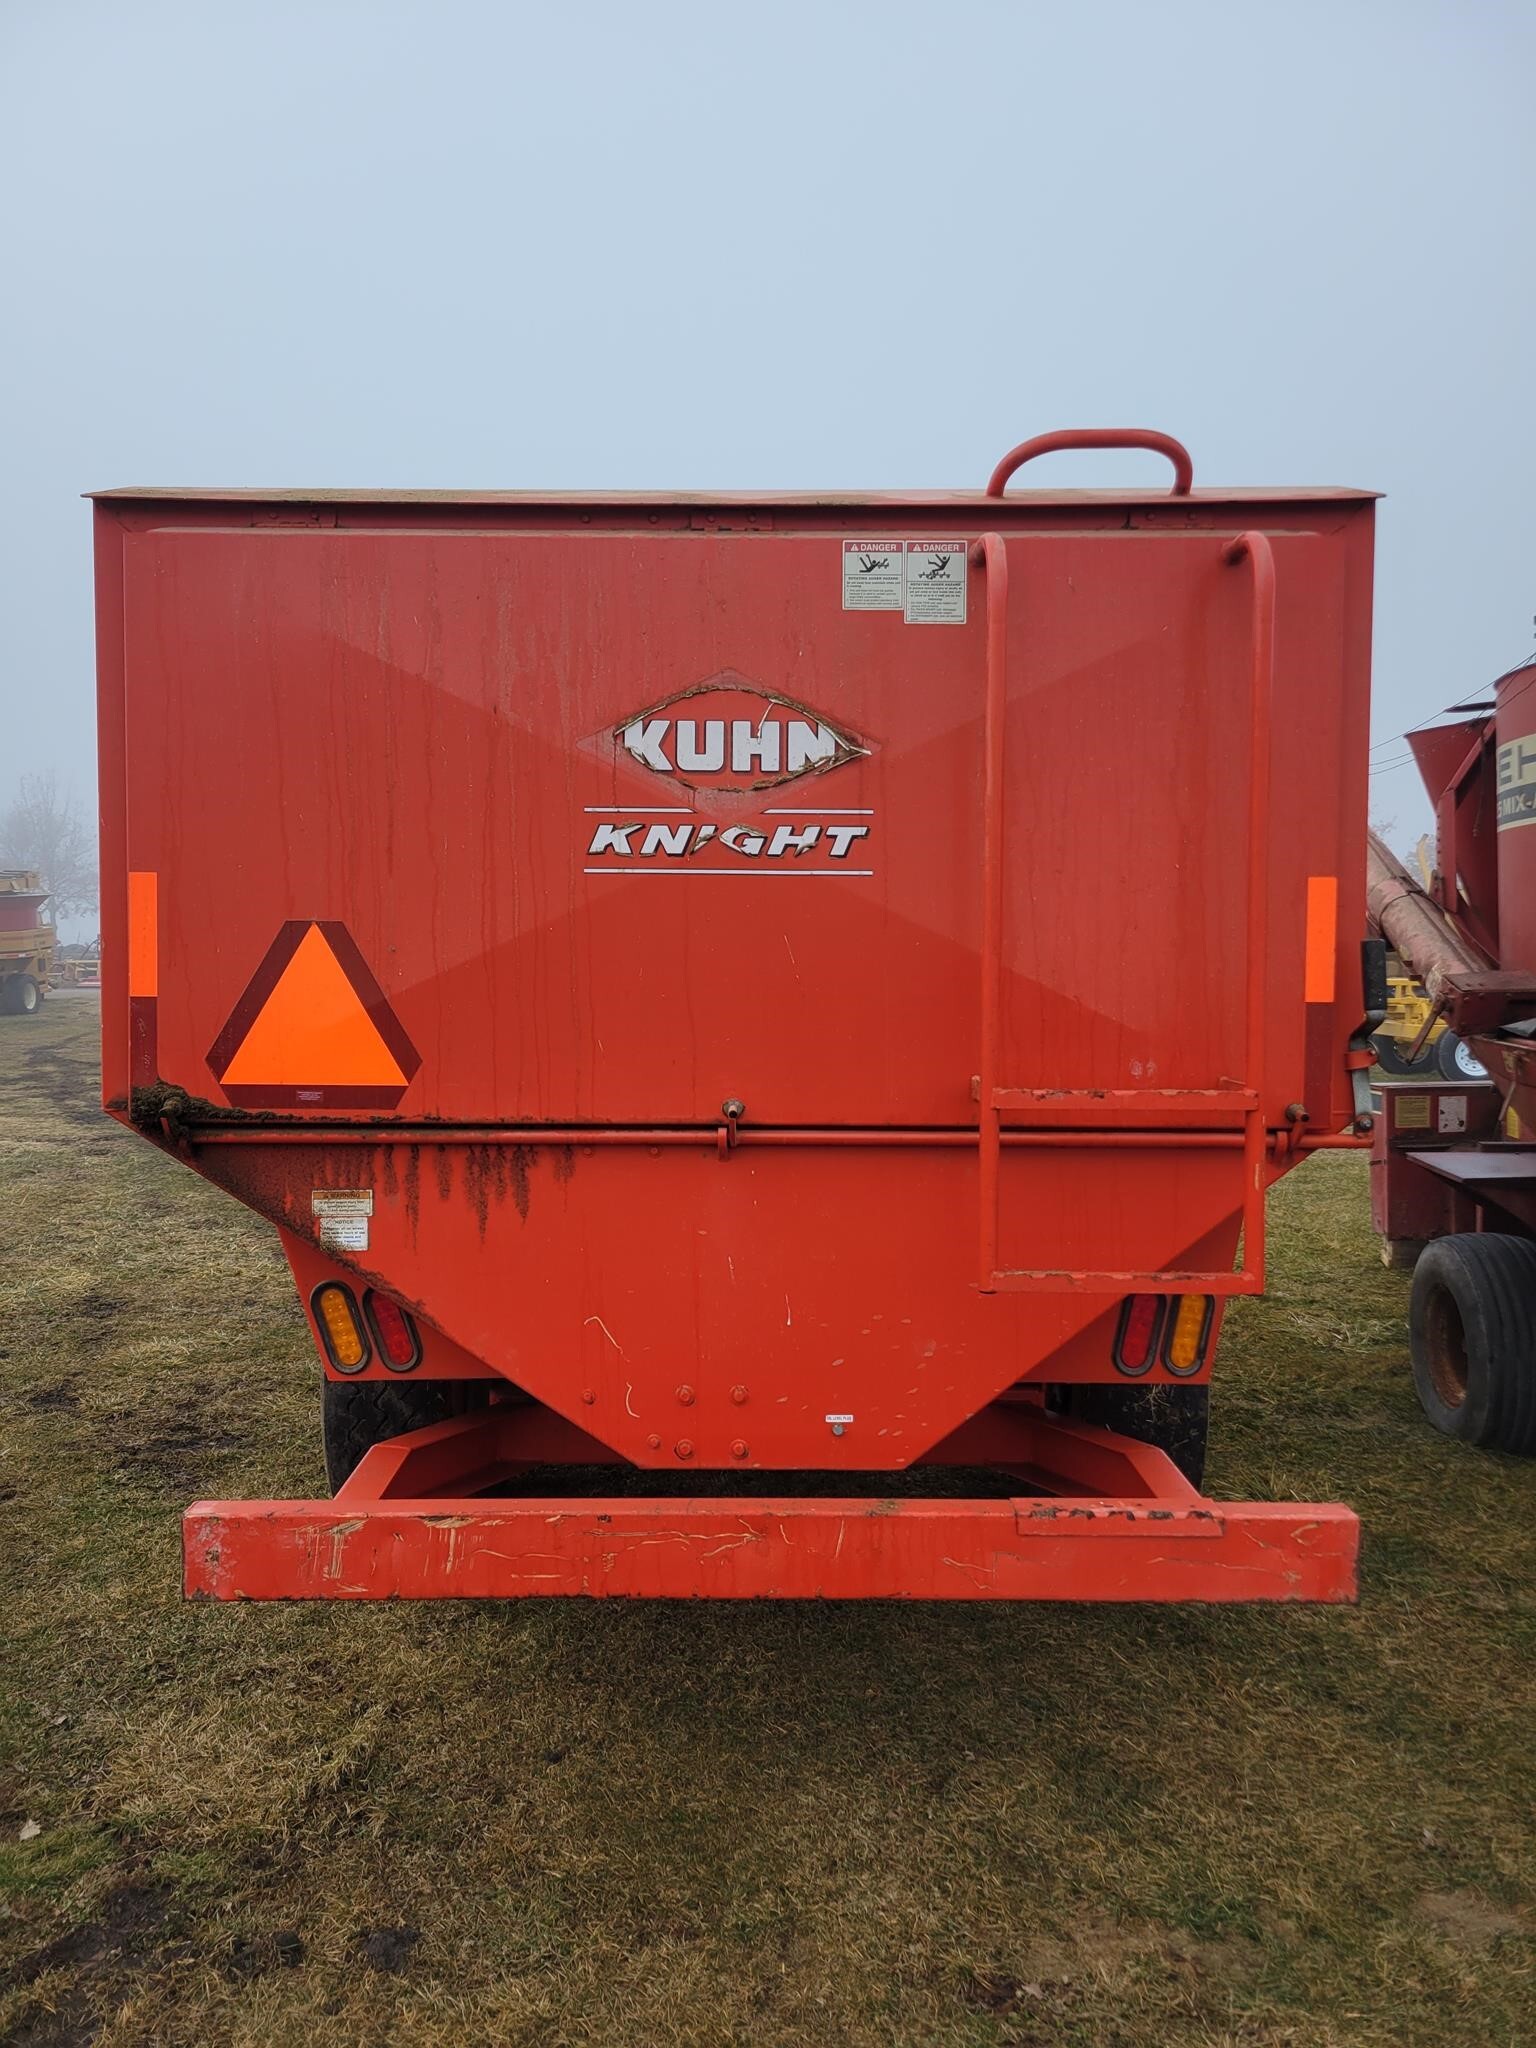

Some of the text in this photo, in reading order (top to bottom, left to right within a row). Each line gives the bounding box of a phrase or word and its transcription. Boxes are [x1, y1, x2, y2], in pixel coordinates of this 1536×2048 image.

[860, 543, 897, 551] DANGER
[922, 543, 959, 552] DANGER
[624, 720, 836, 772] KUHN
[588, 823, 869, 857] KNIGHT
